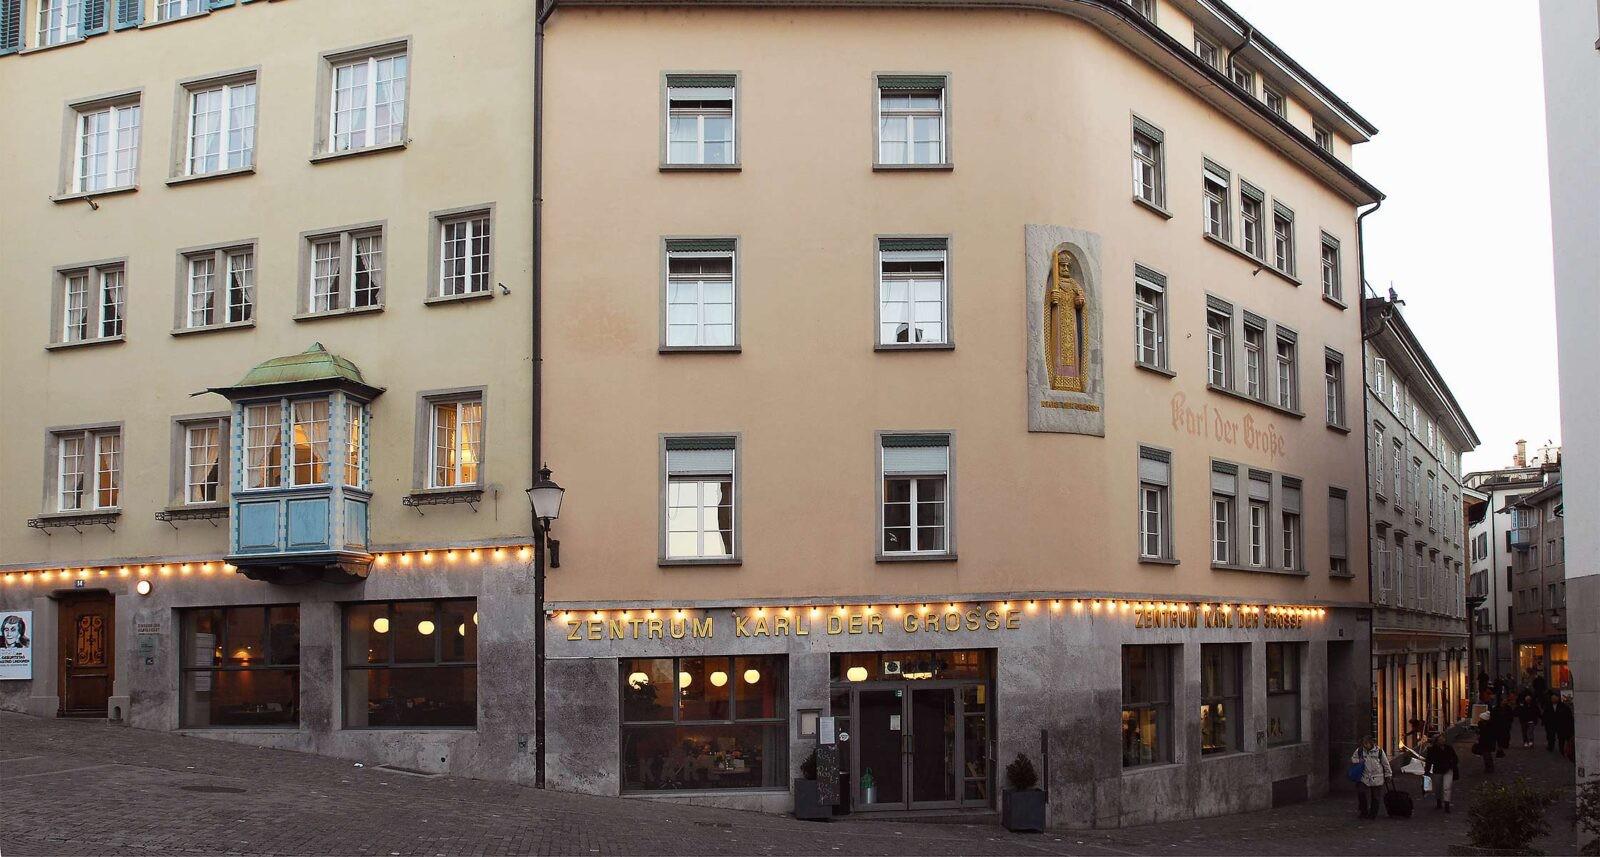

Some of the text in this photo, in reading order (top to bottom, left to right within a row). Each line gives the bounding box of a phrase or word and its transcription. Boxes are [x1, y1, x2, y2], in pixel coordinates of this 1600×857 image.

[1170, 390, 1208, 437] Karl
[1214, 407, 1238, 445] der
[567, 610, 1021, 641] ZENTRUM KARL DER GROSSE
[1135, 609, 1302, 629] ZENTRUM KARL DER GROSSE
